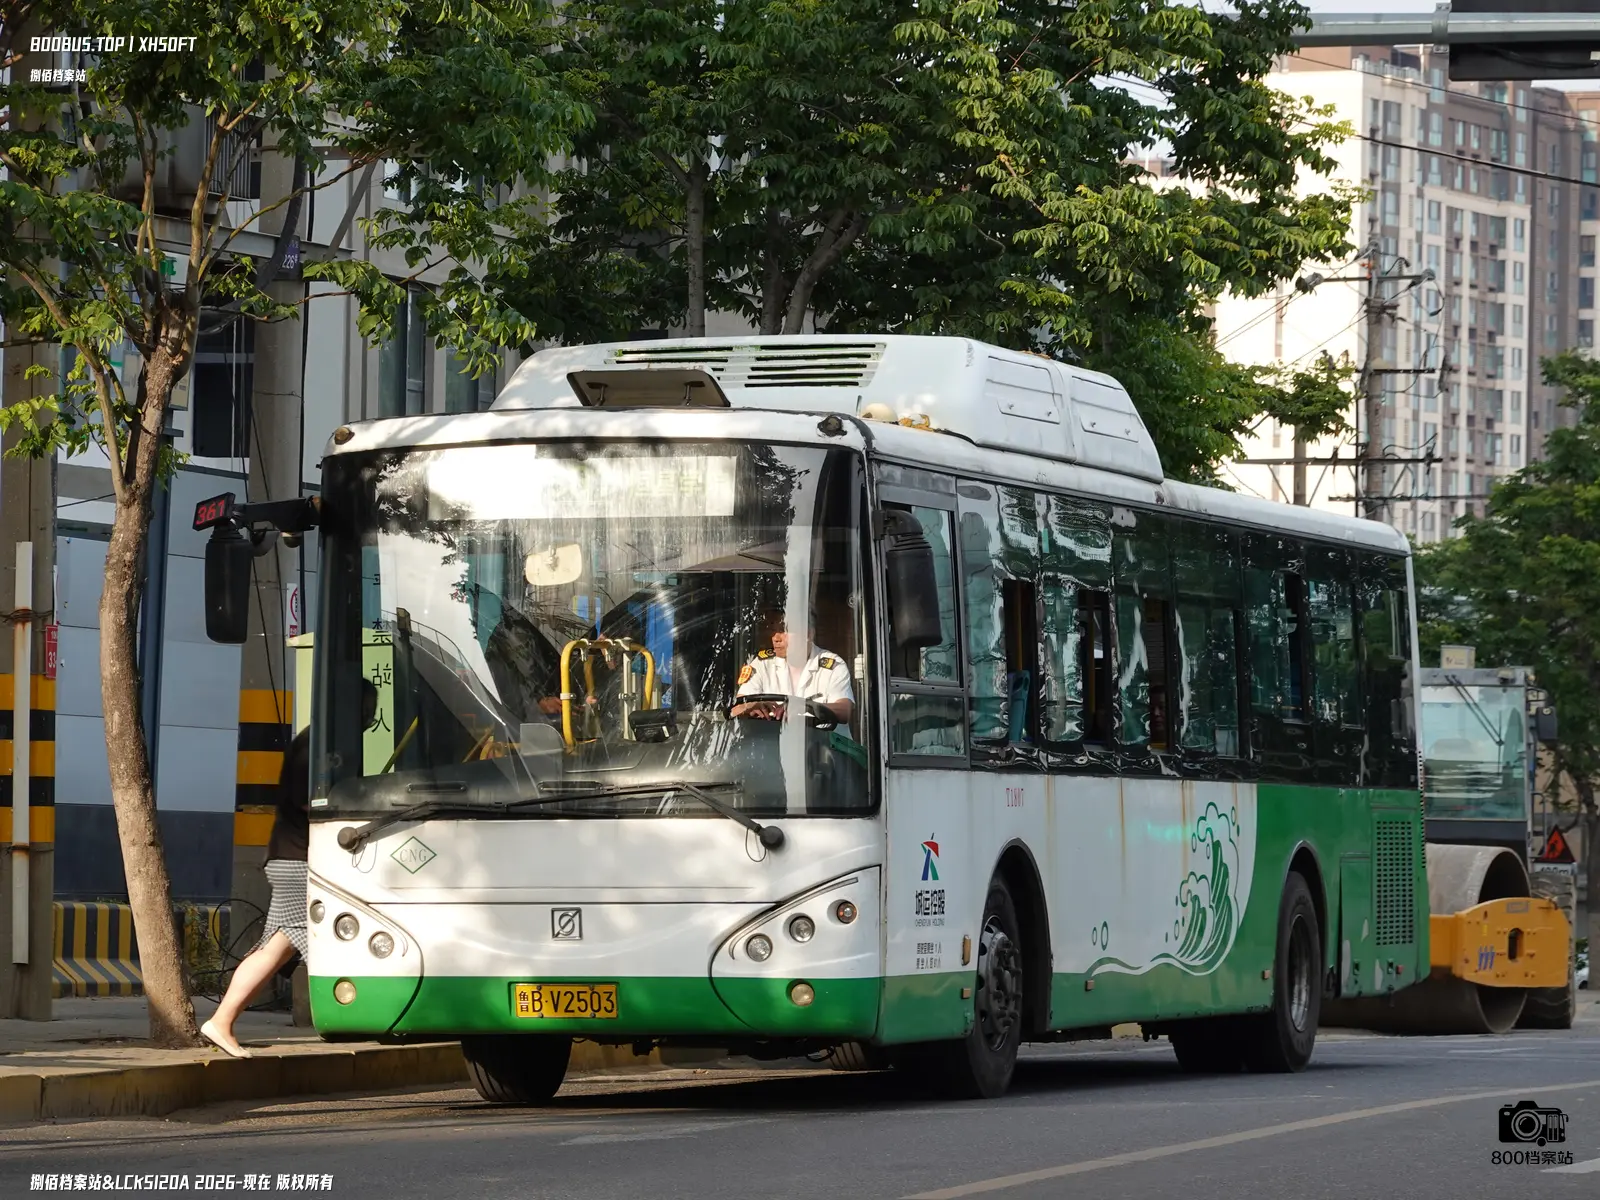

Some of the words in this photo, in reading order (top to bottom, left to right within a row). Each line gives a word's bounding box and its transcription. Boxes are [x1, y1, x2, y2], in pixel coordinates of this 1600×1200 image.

[195, 499, 225, 525] 361
[399, 848, 428, 863] CNG
[915, 889, 945, 916] 城运控股
